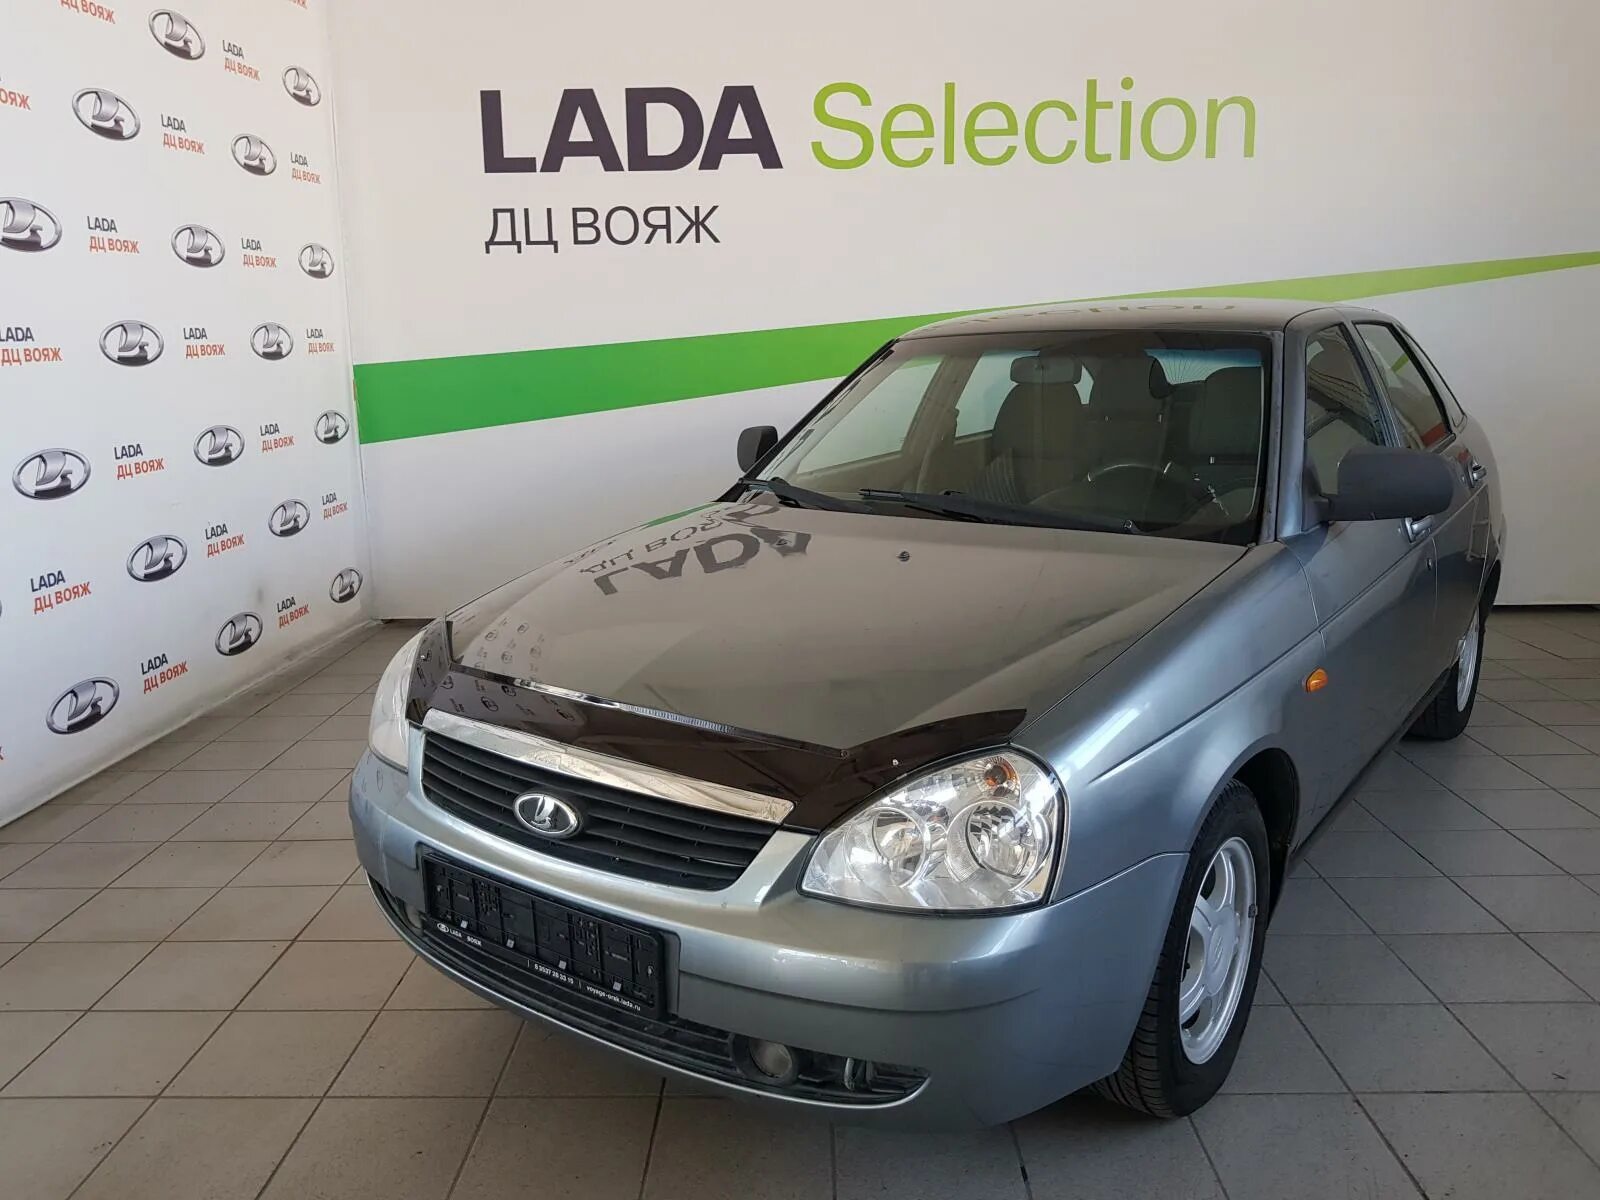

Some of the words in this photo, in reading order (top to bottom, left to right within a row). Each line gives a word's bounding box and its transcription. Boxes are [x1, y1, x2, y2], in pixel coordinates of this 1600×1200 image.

[223, 40, 244, 59] LADA
[225, 56, 236, 74] ДЦ
[237, 59, 259, 80] ВОЯЖ
[161, 114, 187, 133] LADA
[480, 85, 783, 173] LADA
[811, 77, 1255, 170] Selection
[163, 133, 177, 151] ДЦ
[178, 136, 205, 154] ВОЯЖ
[290, 152, 308, 168] LADA
[87, 216, 118, 233] LADA
[485, 208, 559, 254] ДЦ
[571, 205, 720, 245] ВОЯЖ
[89, 236, 107, 253] ДЦ
[108, 239, 140, 254] ВОЯЖ
[241, 238, 262, 251] LADA
[243, 254, 254, 268] ДЦ
[255, 256, 276, 268] ВОЯЖ
[184, 328, 207, 340] LADA
[306, 329, 323, 339] LADA
[1, 349, 22, 367] ДЦ
[24, 348, 63, 363] ВОЯЖ
[186, 345, 199, 359] ДЦ
[200, 344, 226, 356] ВОЯЖ
[260, 424, 280, 436] LADA
[114, 444, 143, 460] LADA
[262, 438, 273, 453] ДЦ
[274, 436, 294, 449] ВОЯЖ
[116, 463, 133, 480] ДЦ
[134, 458, 164, 474] ВОЯЖ
[322, 492, 337, 506] LADA
[205, 524, 228, 540] LADA
[207, 541, 219, 558] ДЦ
[220, 533, 245, 551] ВОЯЖ
[30, 570, 65, 592] LADA
[33, 594, 53, 614] ДЦ
[54, 581, 91, 605] ВОЯЖ
[276, 597, 296, 613] LADA
[278, 613, 290, 629] ДЦ
[290, 603, 309, 621] ВОЯЖ
[141, 653, 168, 675] LADA
[143, 676, 159, 694] ДЦ
[159, 661, 189, 684] ВОЯЖ
